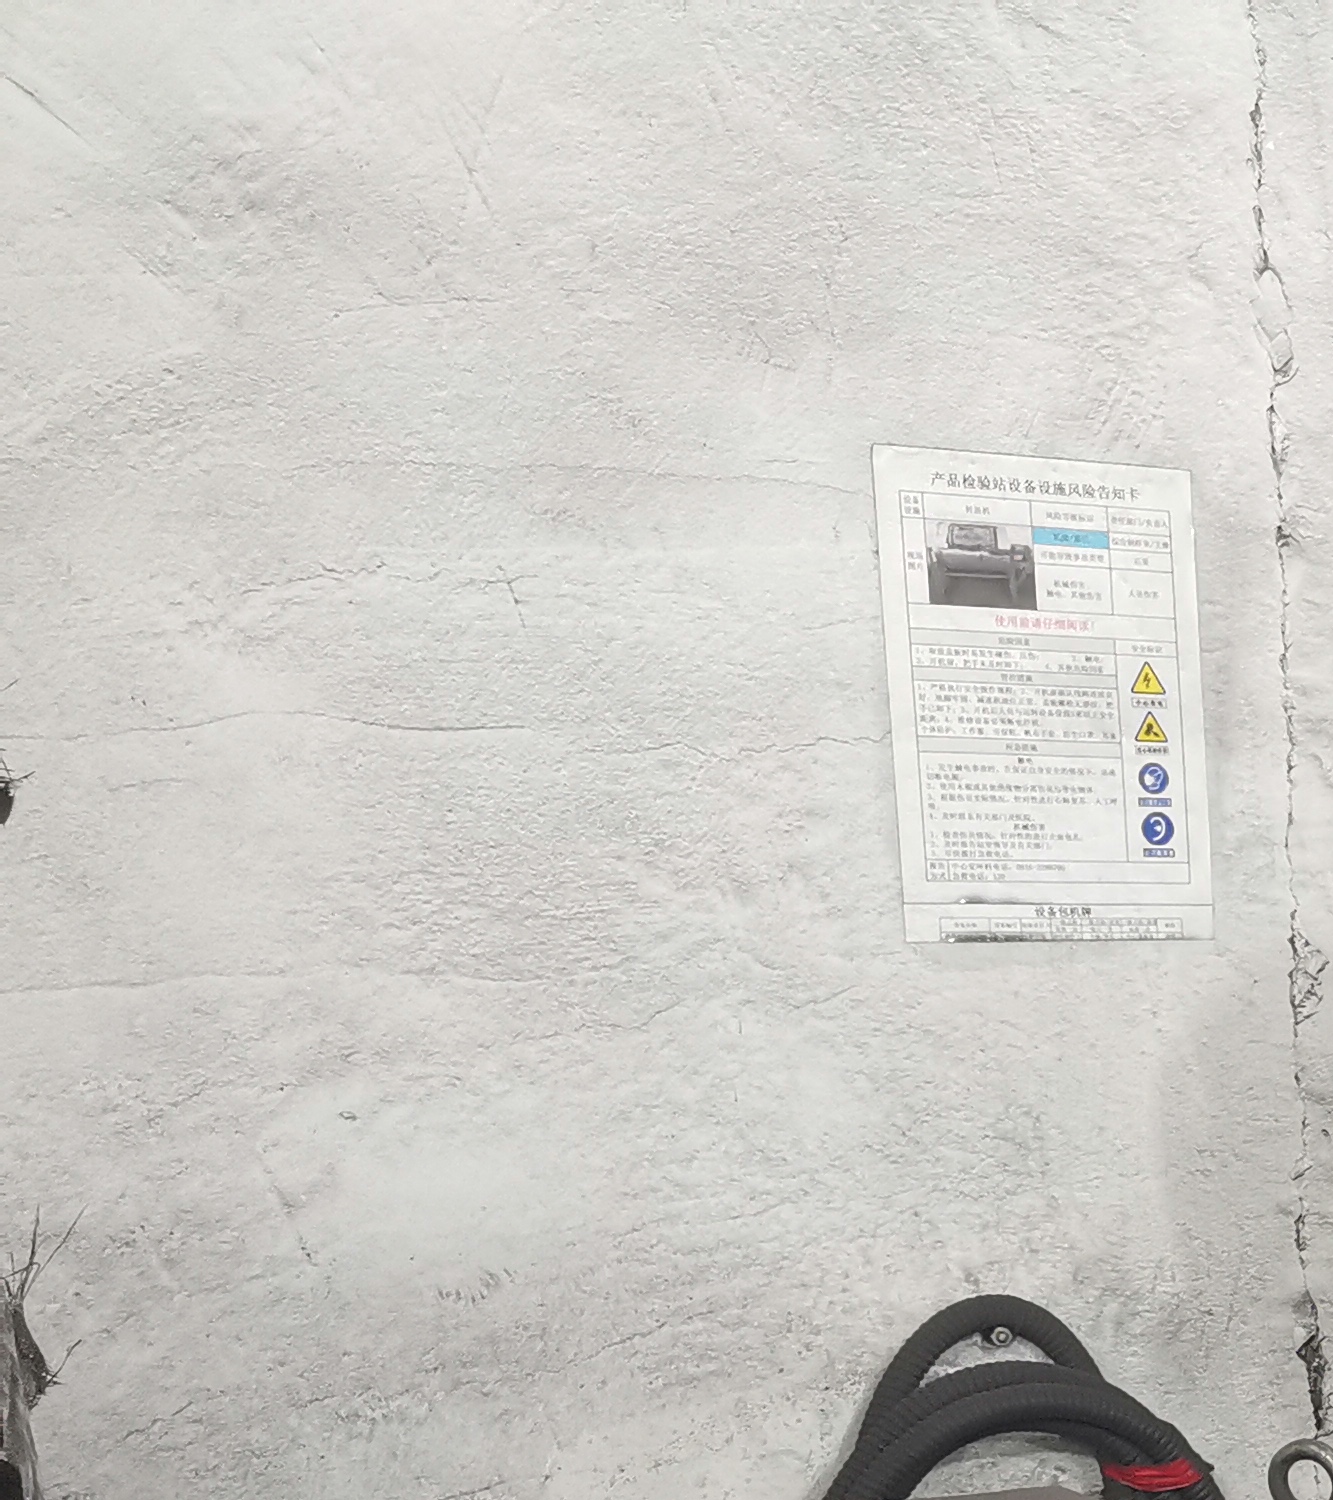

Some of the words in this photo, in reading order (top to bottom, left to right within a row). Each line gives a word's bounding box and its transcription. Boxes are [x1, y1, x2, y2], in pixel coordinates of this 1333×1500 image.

[930, 471, 1140, 502] 产品检验站设备设施风险告知卡
